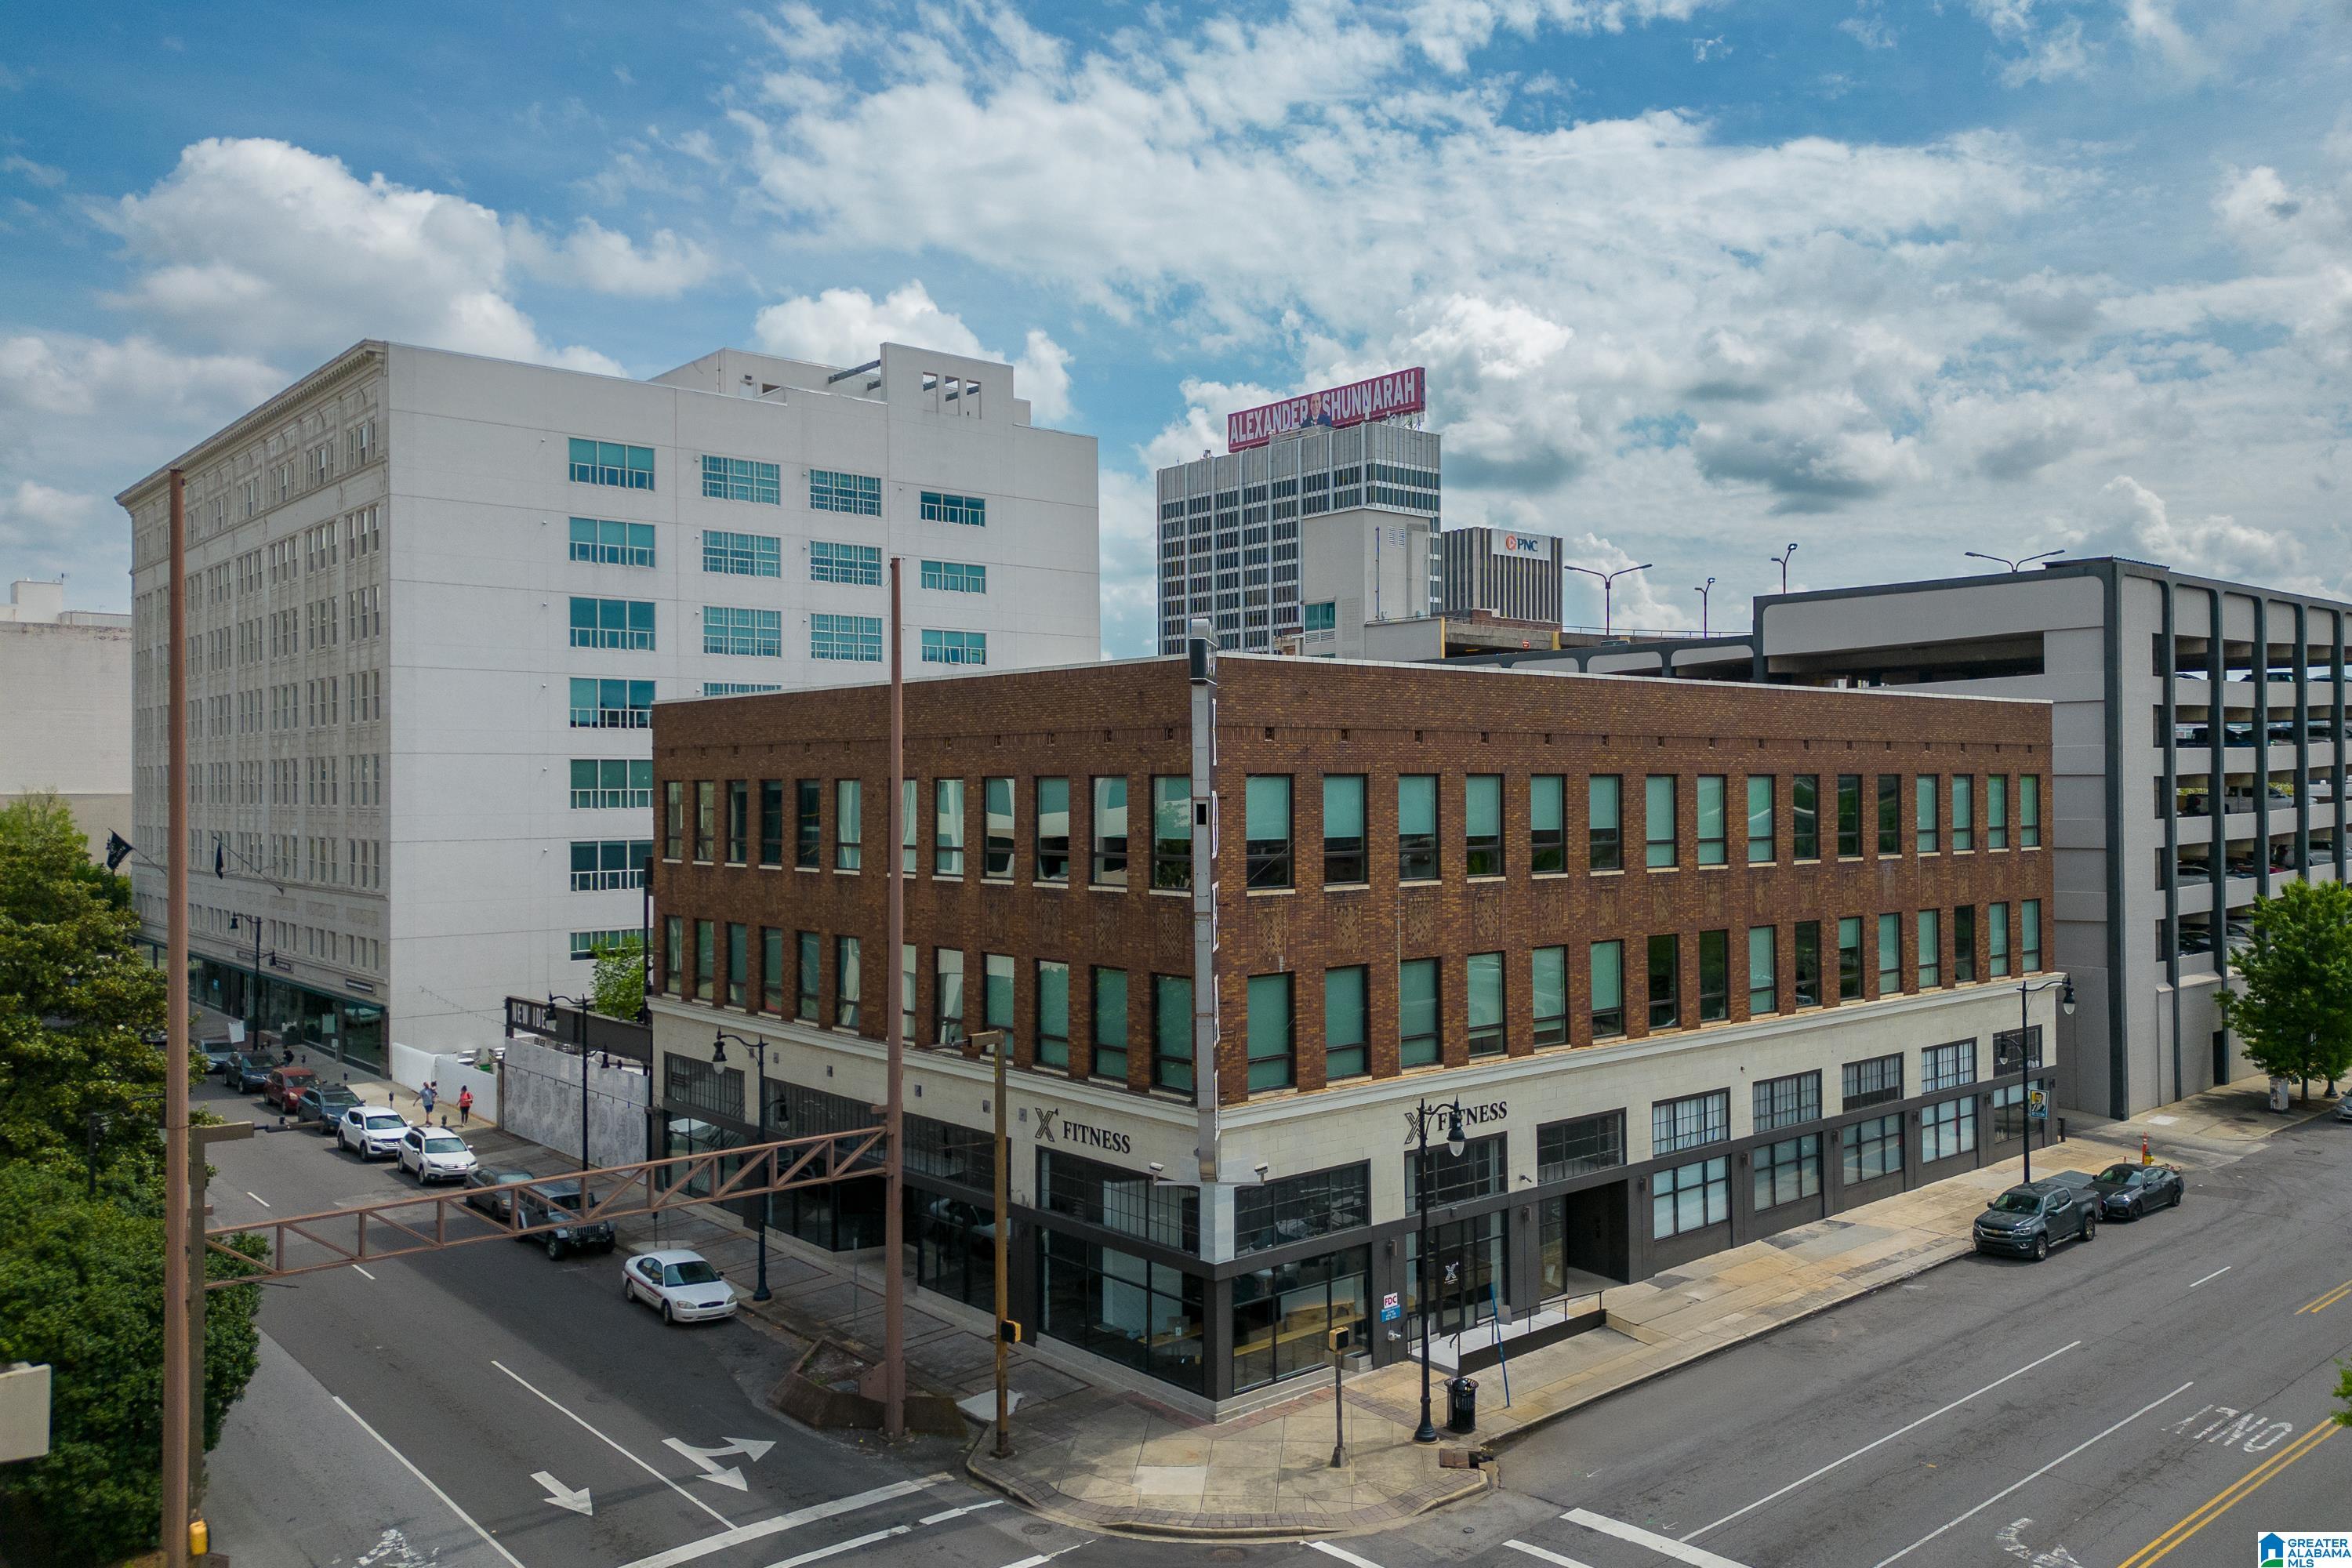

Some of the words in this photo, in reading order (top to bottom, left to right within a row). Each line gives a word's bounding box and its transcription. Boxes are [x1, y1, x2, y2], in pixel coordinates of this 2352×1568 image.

[1230, 398, 1308, 445] ALEXANDER
[1322, 372, 1415, 421] SHUNNARAH
[1517, 538, 1538, 552] PNC
[512, 1002, 528, 1025] NEW
[1062, 1120, 1131, 1154] FITNESS
[1385, 1295, 1397, 1306] FDC
